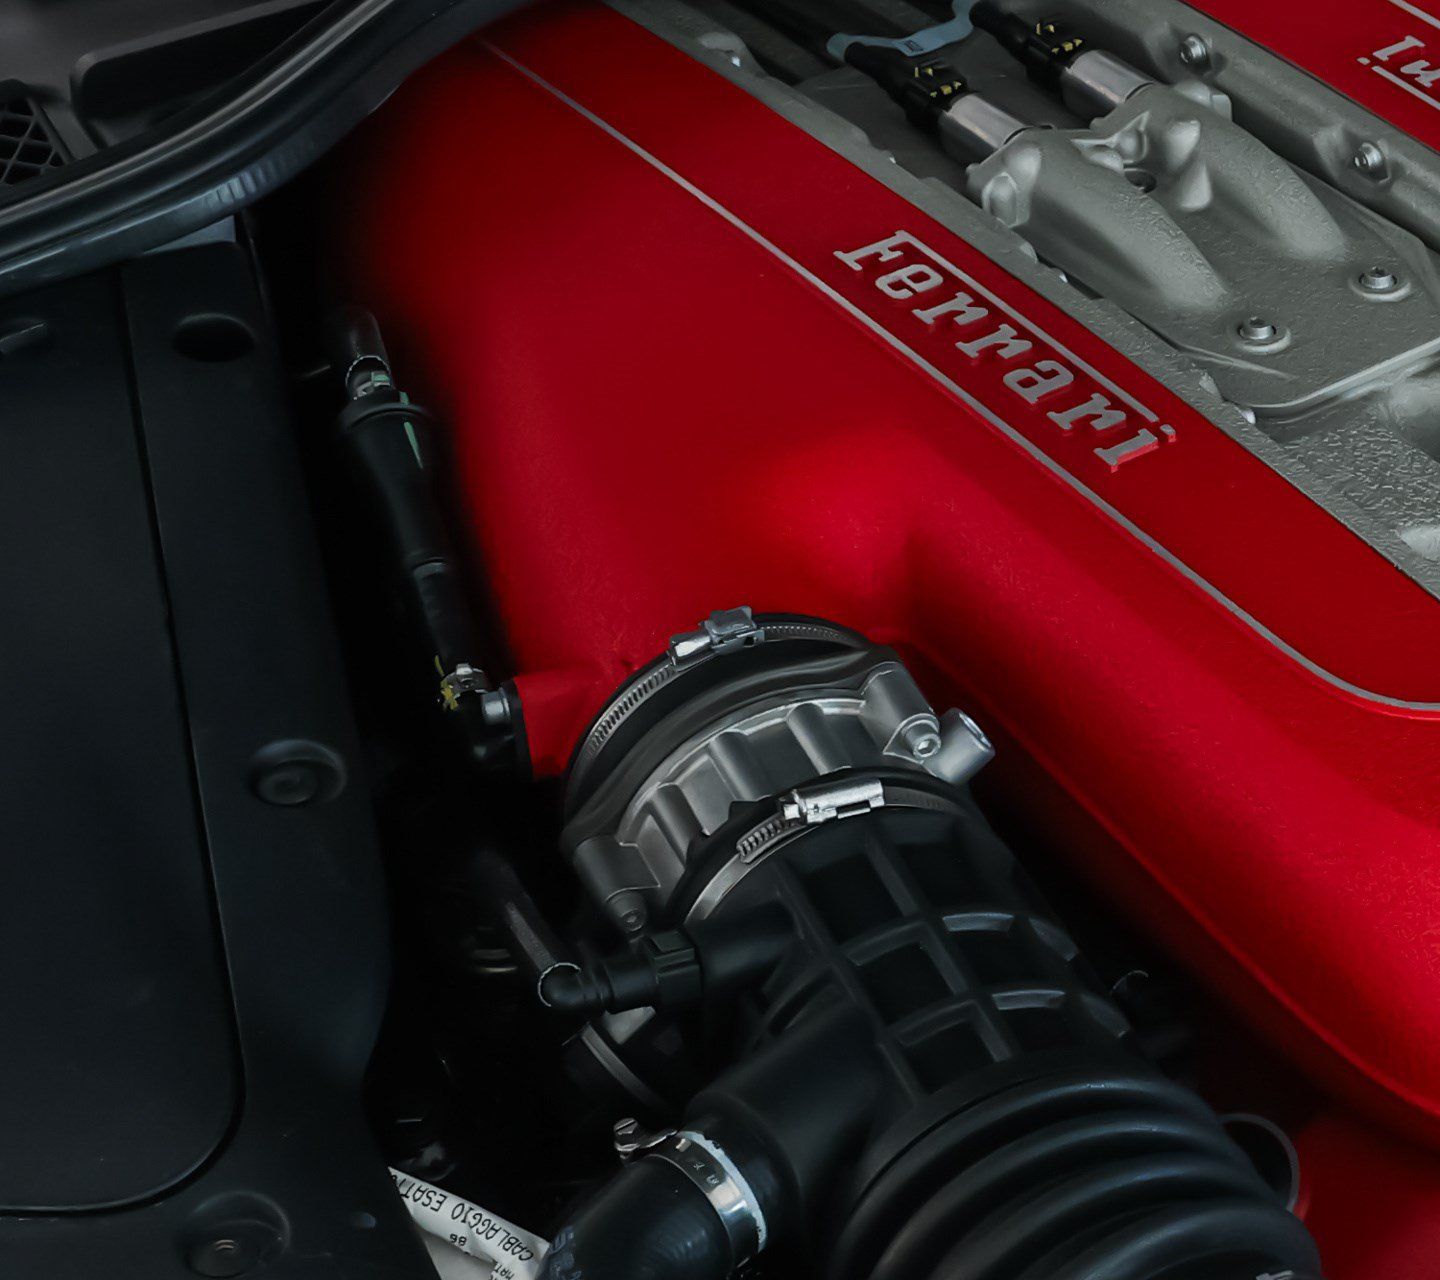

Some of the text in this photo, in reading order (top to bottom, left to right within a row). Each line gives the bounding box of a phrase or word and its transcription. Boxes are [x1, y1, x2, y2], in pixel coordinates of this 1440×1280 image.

[832, 228, 1178, 472] Ferrari
[449, 1233, 468, 1247] 86
[450, 1203, 535, 1262] CABLAGGIO
